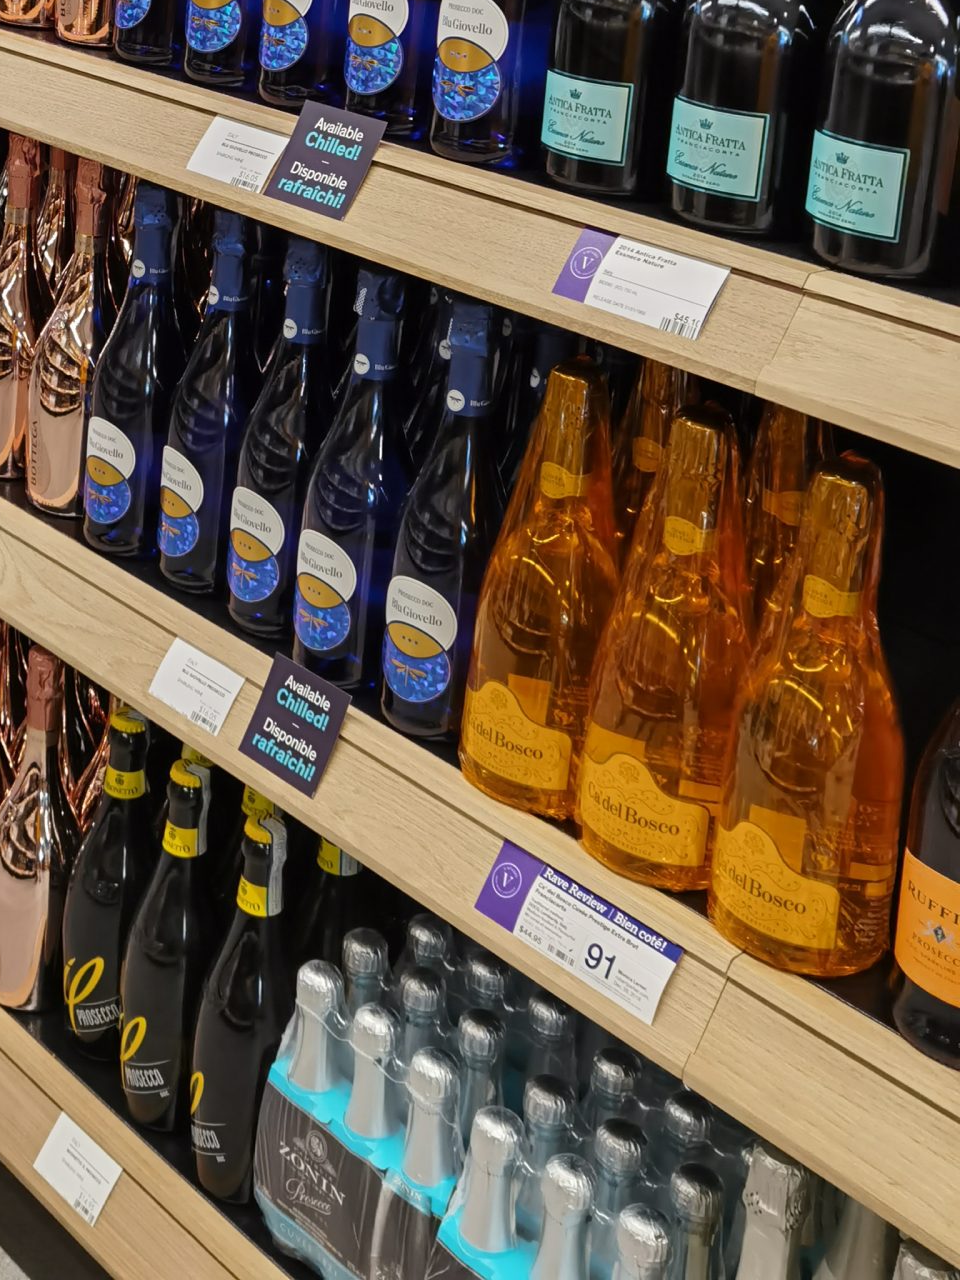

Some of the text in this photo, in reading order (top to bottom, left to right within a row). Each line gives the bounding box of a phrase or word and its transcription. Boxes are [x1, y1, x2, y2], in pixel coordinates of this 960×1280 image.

[448, 3, 485, 16] PROSECCO DOC
[453, 19, 493, 36] Giovello
[574, 103, 613, 119] FRATTA
[314, 117, 364, 142] Available
[705, 133, 746, 151] FRATTA
[305, 131, 363, 161] Chilled!
[238, 170, 259, 183] $16.05
[290, 160, 348, 191] Disponible
[840, 167, 884, 188] FRATTA
[277, 177, 346, 209] rafraîchi!
[618, 244, 678, 267] 2014 Antica Fratta
[642, 257, 665, 269] Nature
[30, 420, 38, 486] BOTTEGA
[94, 442, 124, 460] Giovello
[240, 516, 272, 534] Giovello
[308, 558, 343, 579] Giovello
[324, 551, 334, 561] DOC
[398, 588, 434, 608] PROSECCO DOC
[392, 598, 443, 628] Blu Giovello
[284, 674, 332, 712] Available
[199, 705, 218, 720] $16.05
[276, 687, 330, 731] Chilled!
[263, 716, 317, 762] Disponible
[495, 732, 543, 760] Bosco
[252, 733, 316, 782] rafraîchi!
[602, 795, 680, 835] del Bosco
[728, 865, 806, 915] del Bosco
[543, 867, 668, 952] Rave Review Bien coté!
[519, 925, 543, 945] $44.95
[588, 914, 611, 933] Prestige
[610, 928, 626, 942] Extra
[626, 937, 640, 951] Brut
[584, 943, 617, 980] 91
[76, 1004, 120, 1027] PROSECCO
[125, 1067, 164, 1087] PROSECCO
[279, 1141, 346, 1206] ZONIN
[286, 1177, 332, 1215] Prosecco
